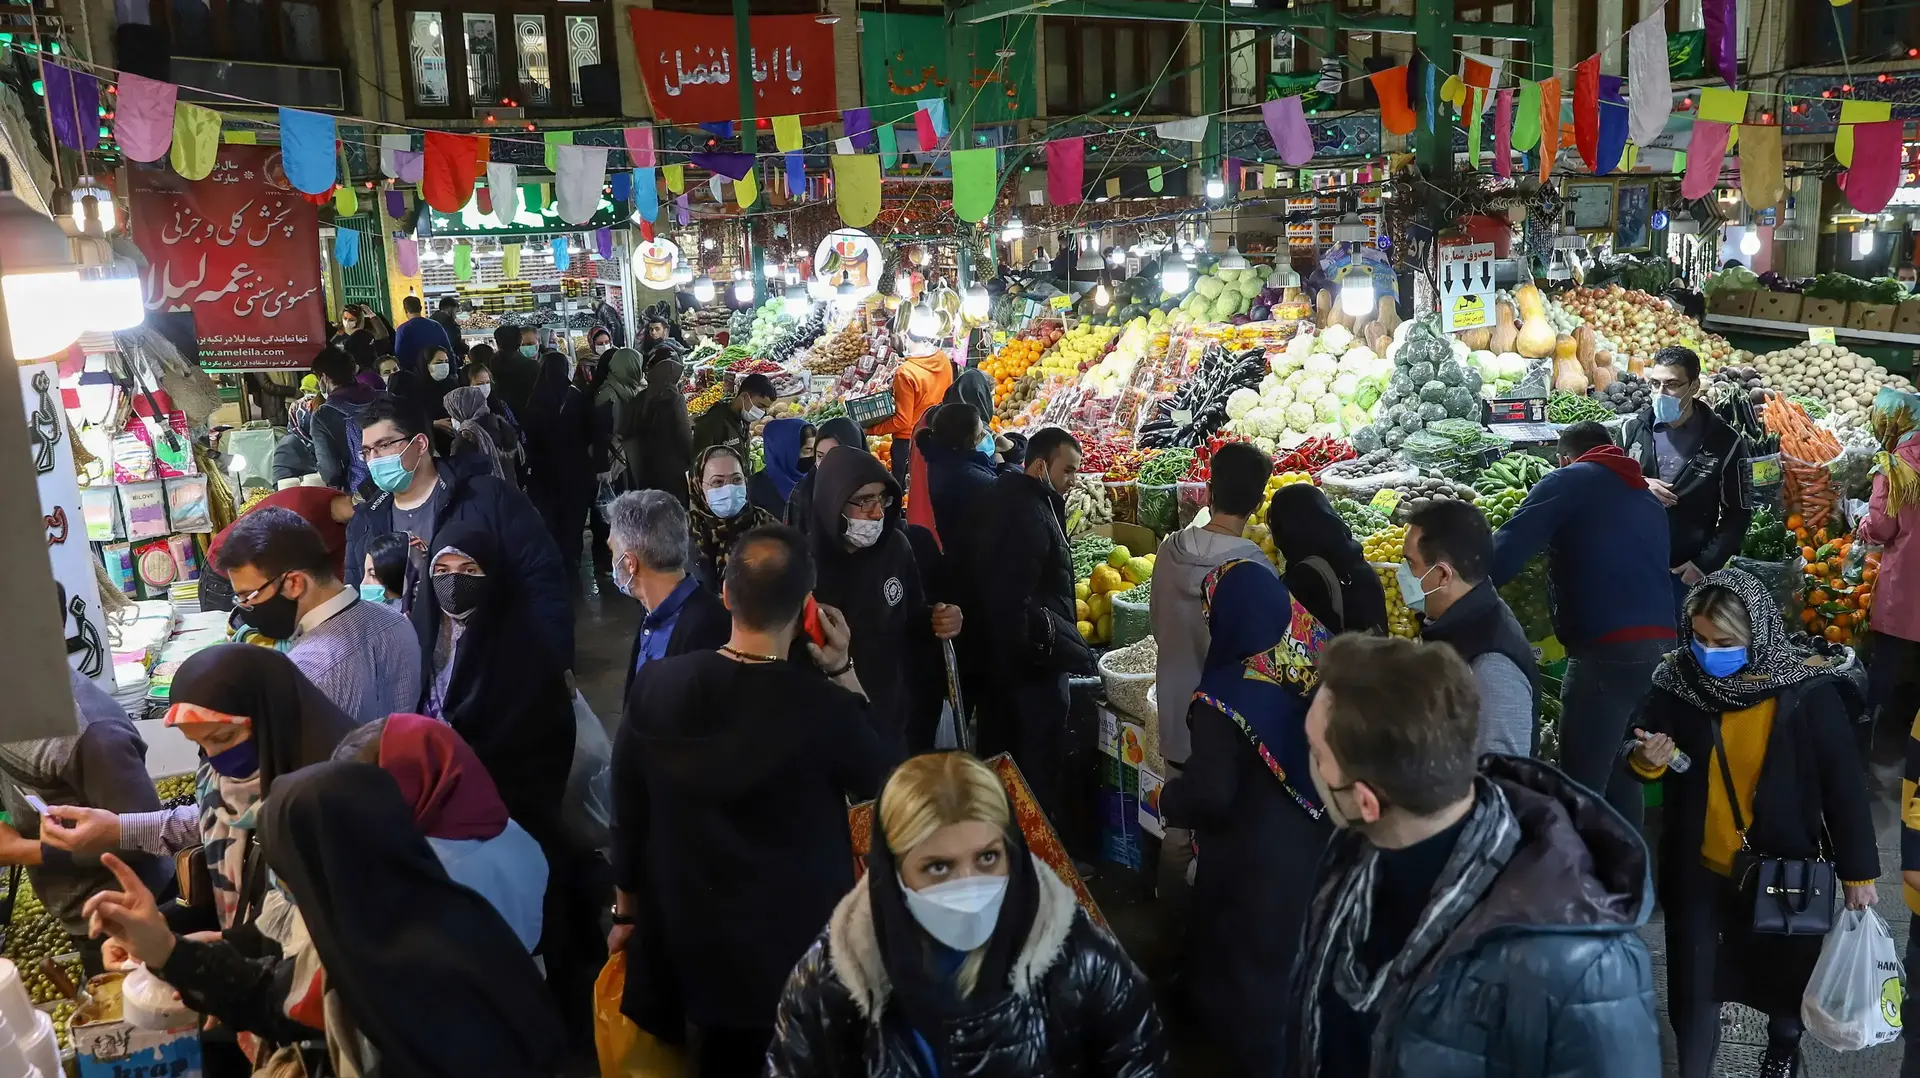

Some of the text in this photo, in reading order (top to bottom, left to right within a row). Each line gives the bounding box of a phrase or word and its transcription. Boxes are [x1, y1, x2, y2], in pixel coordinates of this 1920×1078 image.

[221, 159, 239, 171] سال
[212, 173, 240, 185] مبارک
[216, 199, 255, 246] کلی
[247, 200, 294, 247] پخش
[204, 223, 214, 238] و
[1444, 249, 1465, 264] شماره
[1466, 248, 1493, 262] صندوق
[144, 252, 318, 318] سمنوی سنتی عمه لیلا
[206, 334, 223, 345] تکیه
[223, 335, 234, 345] در
[233, 334, 246, 345] لیلا
[246, 335, 261, 343] عمه
[295, 334, 308, 344] تنها
[199, 347, 285, 357] ww.ameleila.com
[1876, 960, 1899, 972] HAN
